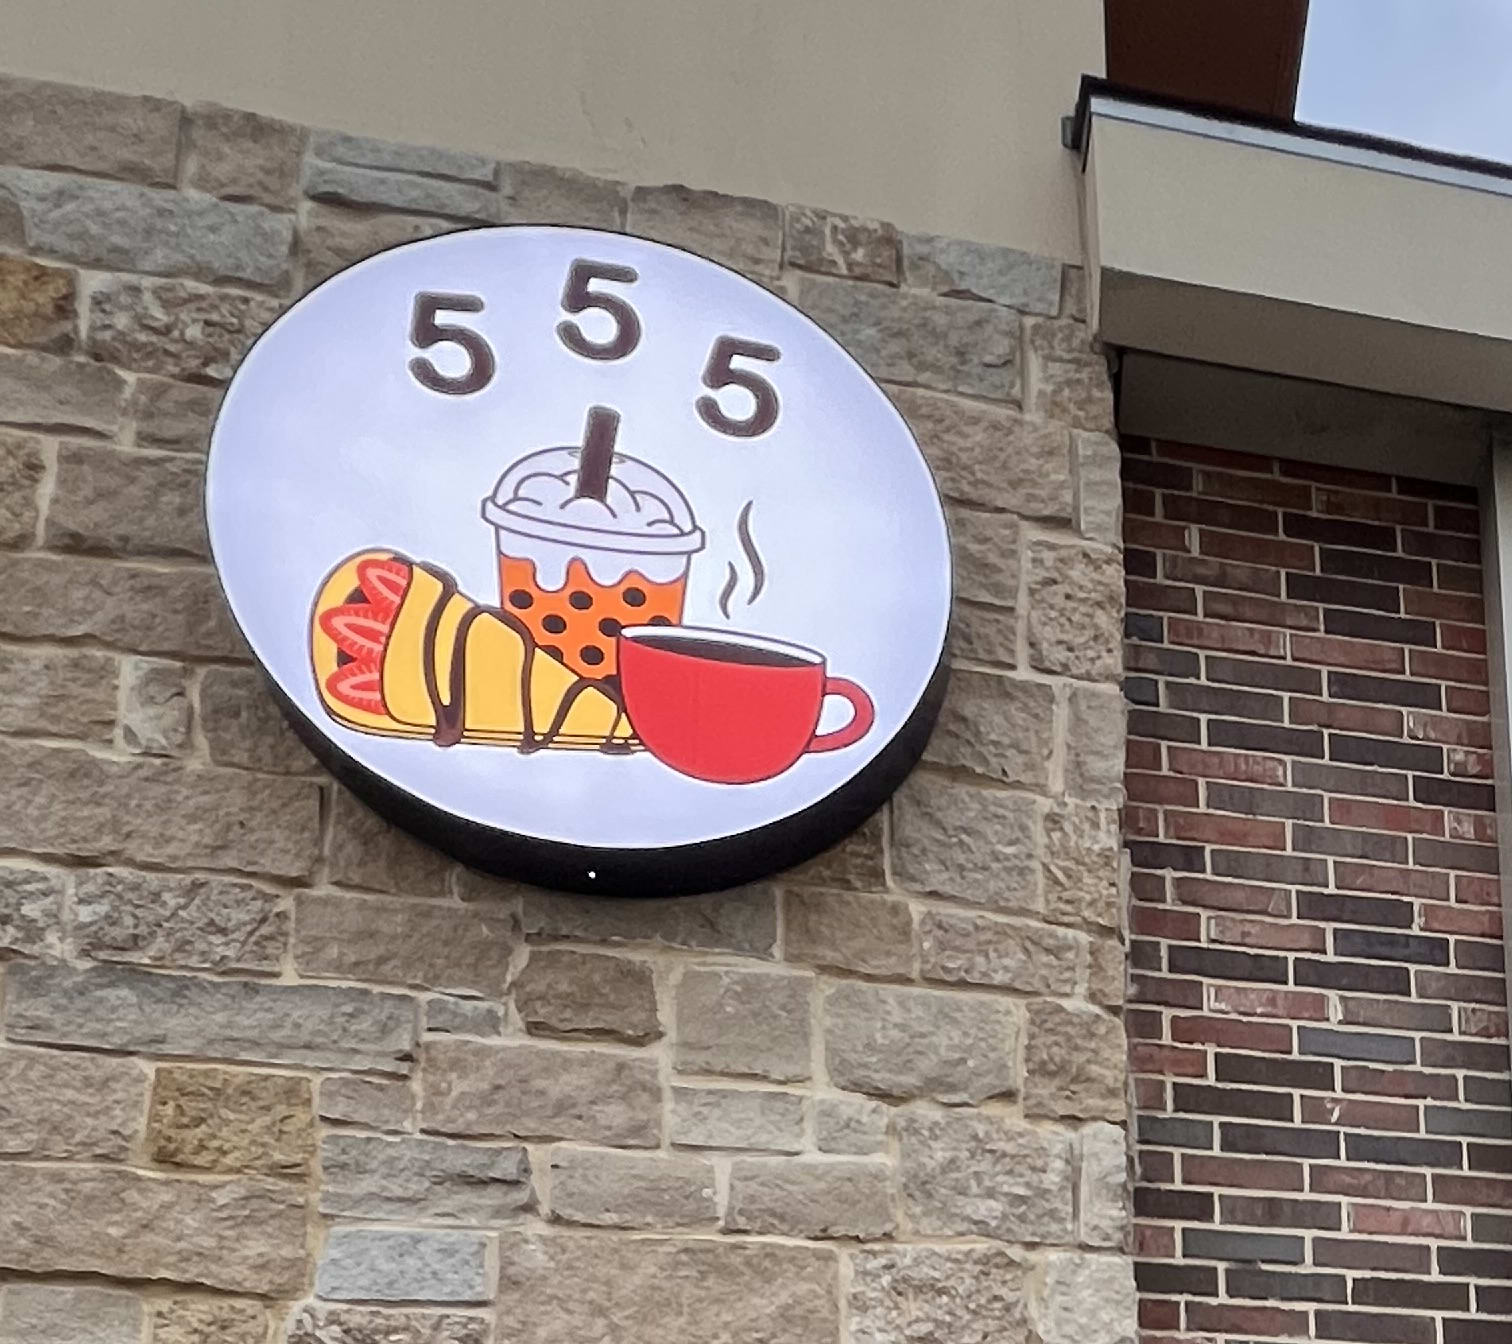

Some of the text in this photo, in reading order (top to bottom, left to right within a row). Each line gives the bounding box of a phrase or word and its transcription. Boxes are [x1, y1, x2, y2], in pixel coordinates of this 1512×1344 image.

[408, 259, 781, 437] 5 5 5
